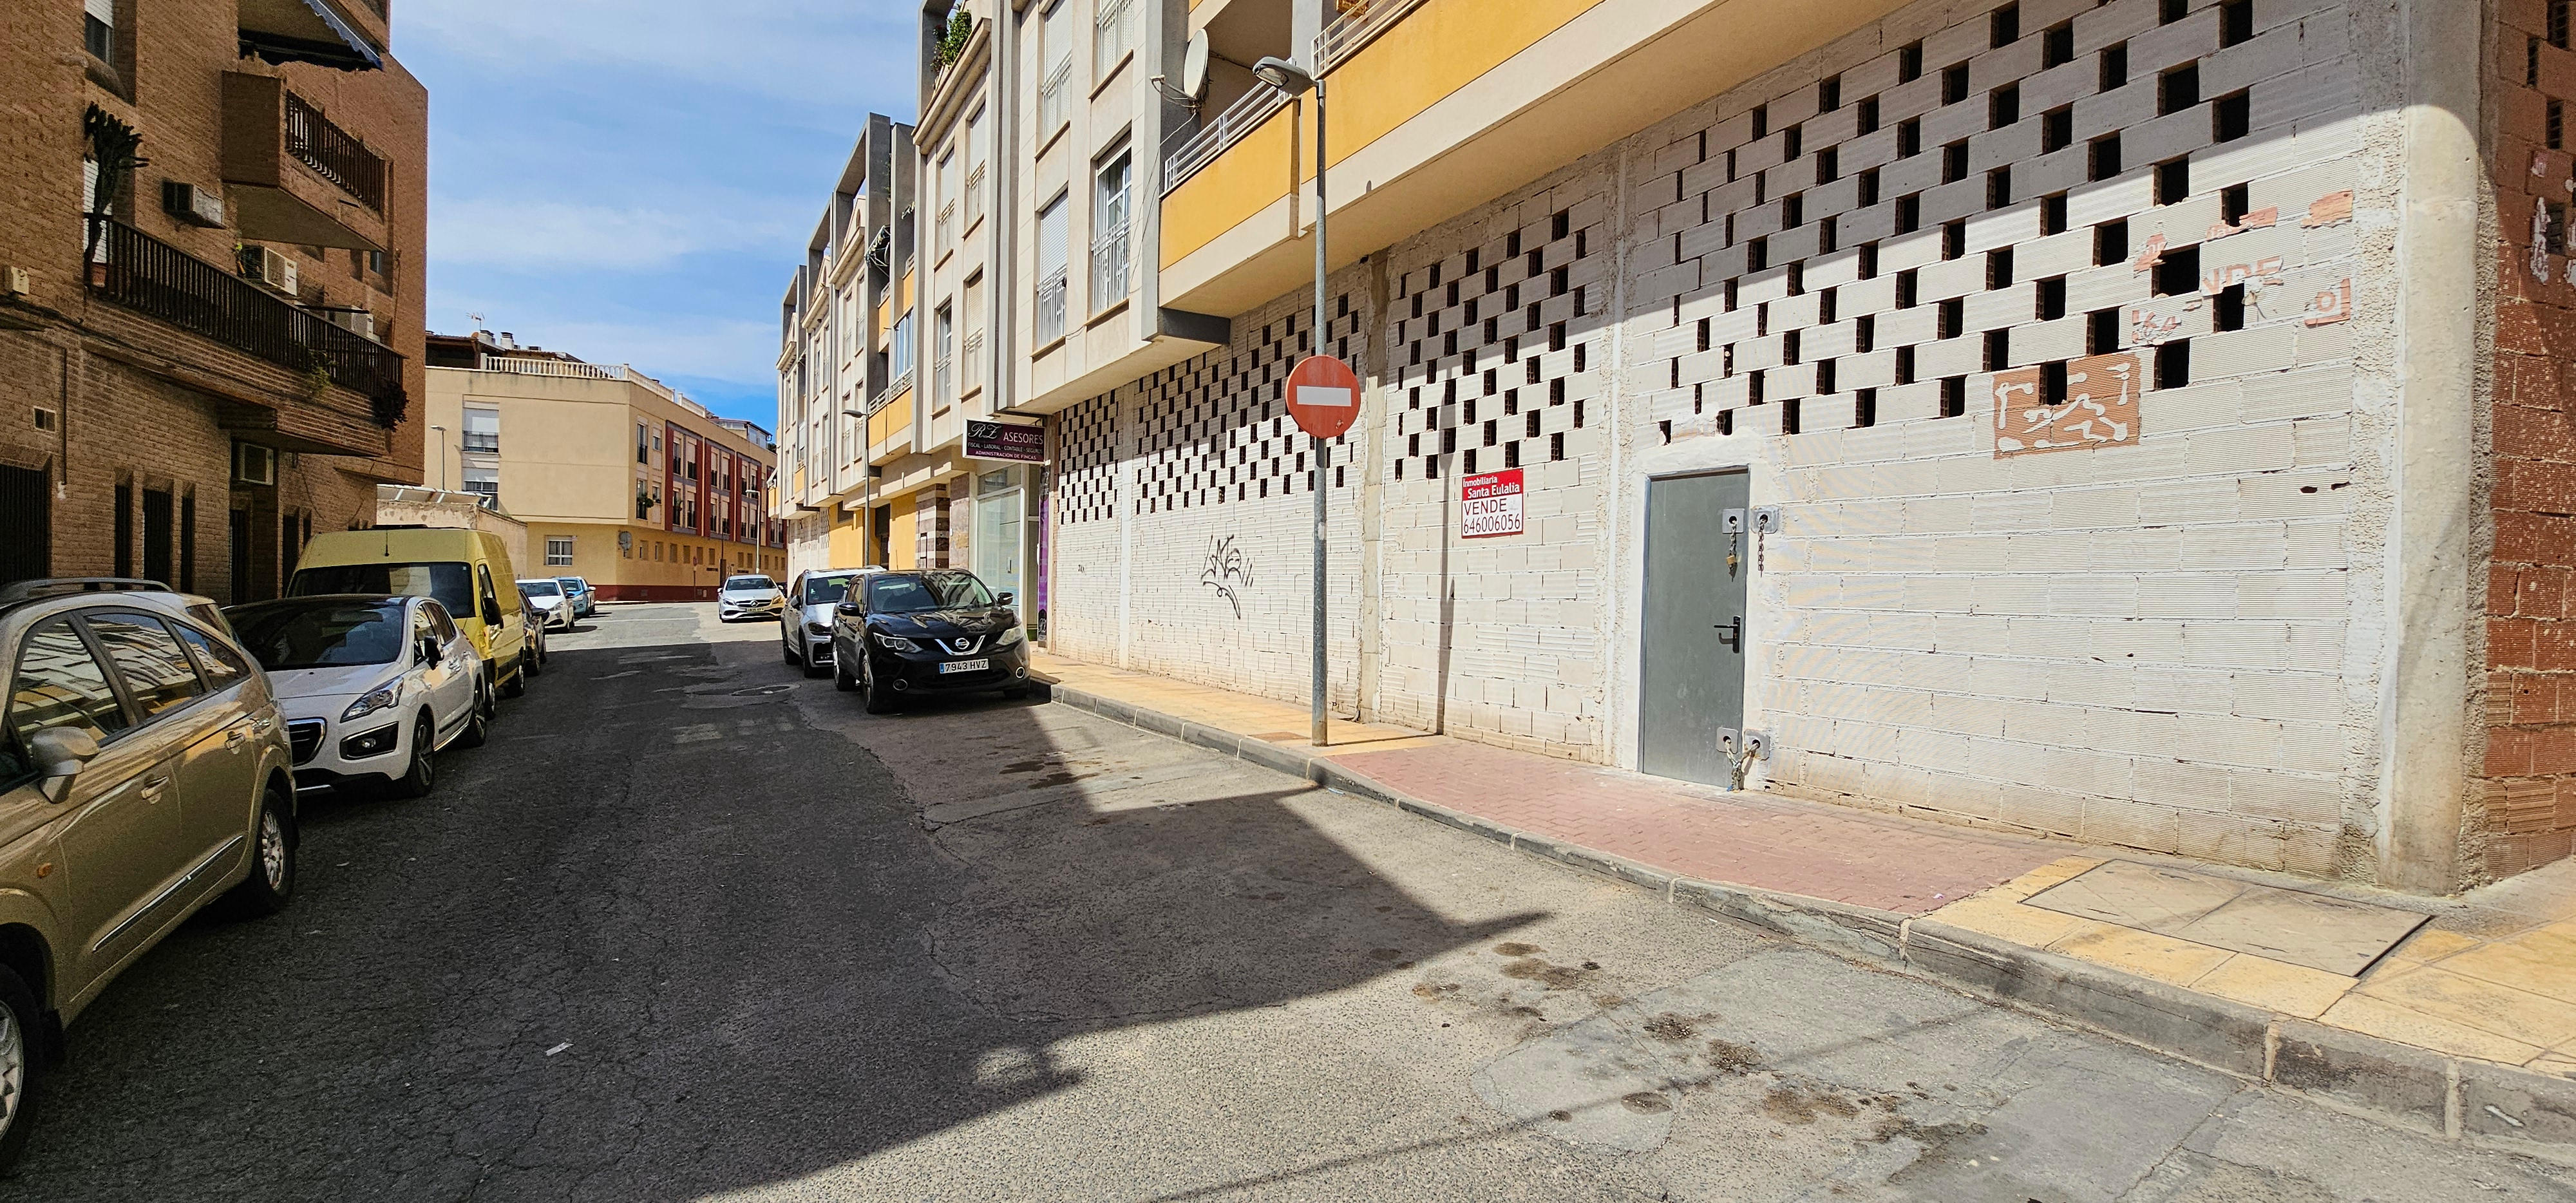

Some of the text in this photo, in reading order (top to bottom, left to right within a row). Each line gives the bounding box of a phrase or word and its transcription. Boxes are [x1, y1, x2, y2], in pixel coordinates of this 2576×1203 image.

[1003, 431, 1043, 444] ASESORES
[1468, 482, 1520, 498] Santa Eulalia
[1464, 498, 1507, 515] VENDE
[1464, 513, 1520, 534] 646006056
[945, 660, 987, 672] 7943 HVZ
